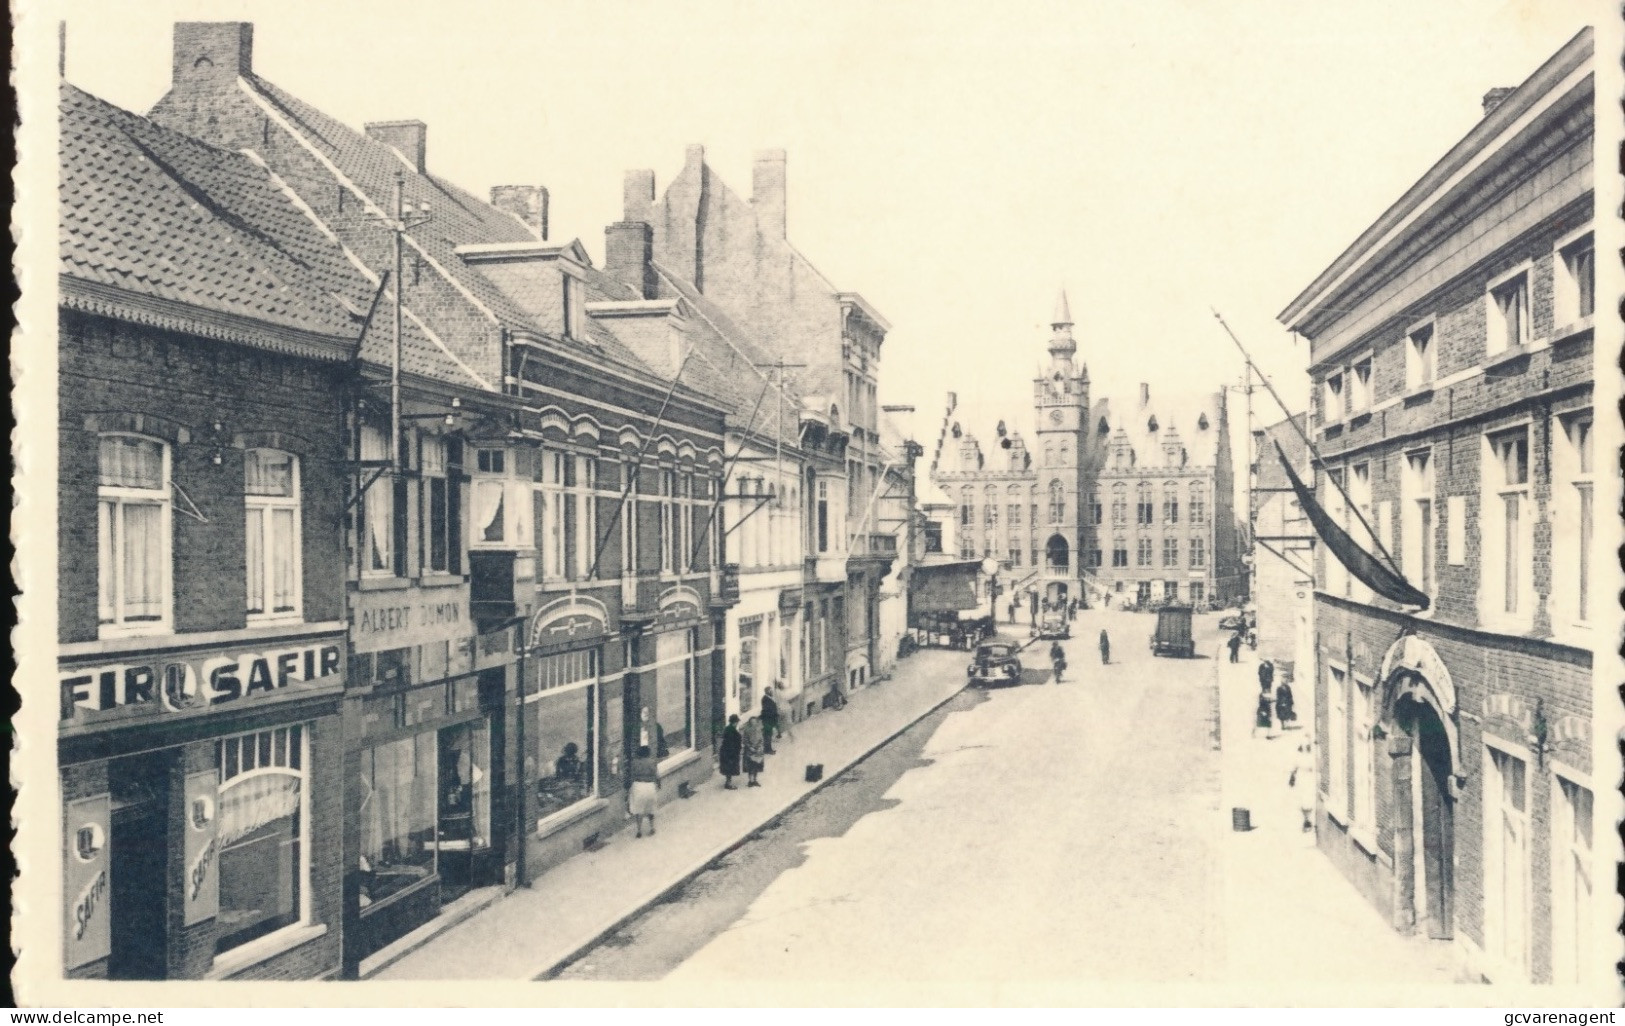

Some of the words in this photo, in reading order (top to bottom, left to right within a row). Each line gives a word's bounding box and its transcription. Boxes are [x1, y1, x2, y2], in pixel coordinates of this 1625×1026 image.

[361, 606, 411, 633] ALBERT
[209, 646, 341, 706] SAFIR
[77, 870, 106, 941] SAFIR
